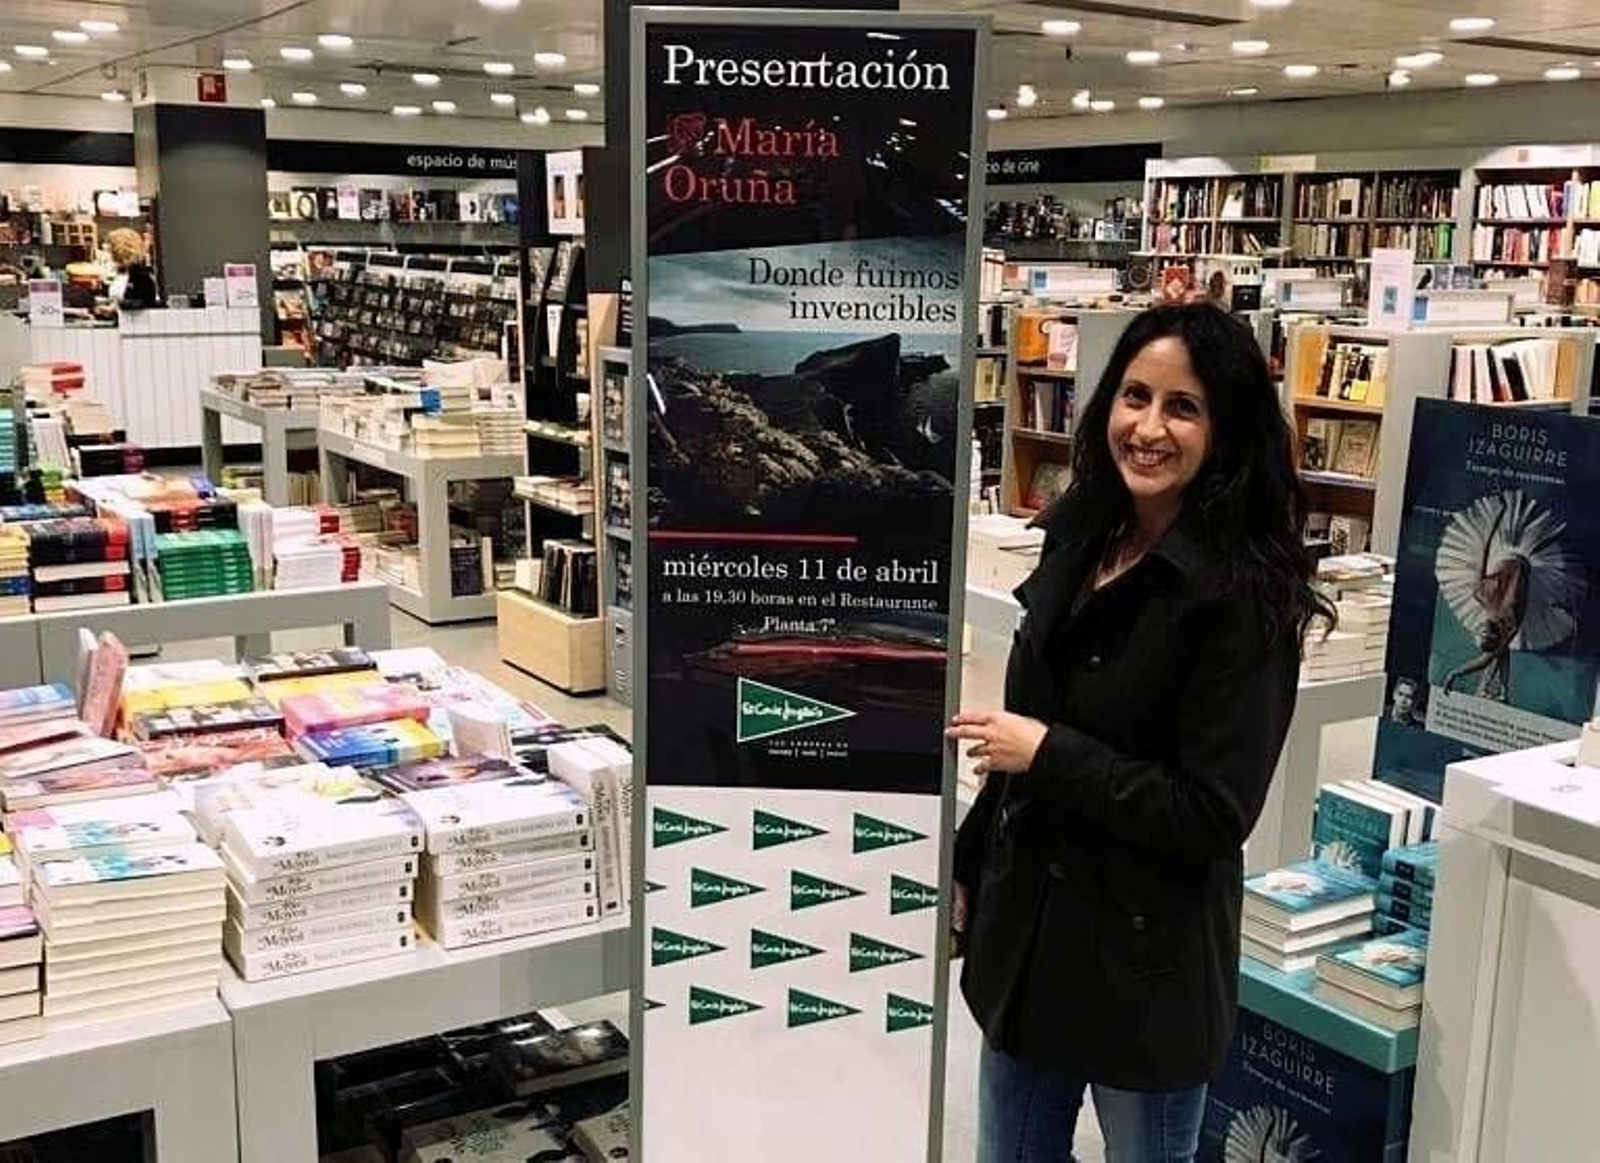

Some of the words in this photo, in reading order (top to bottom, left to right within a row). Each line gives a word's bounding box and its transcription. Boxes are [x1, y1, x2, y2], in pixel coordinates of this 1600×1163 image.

[661, 44, 950, 91] Presentación
[714, 117, 840, 157] María
[407, 152, 463, 172] espacio
[467, 153, 486, 169] de
[664, 166, 797, 204] Oruña
[747, 256, 845, 288] Donde
[855, 259, 961, 290] fuimos
[788, 290, 958, 322] invencibles
[1492, 423, 1548, 445] BORIS
[1467, 435, 1567, 468] IZAGUIRRE
[662, 553, 789, 578] miércoles
[799, 557, 827, 580] 11
[836, 557, 867, 581] de
[875, 558, 938, 584] abril
[662, 592, 673, 603] a
[676, 587, 700, 603] las
[750, 587, 794, 605] horas
[797, 594, 817, 607] en
[821, 592, 836, 607] el
[840, 592, 938, 609] Restaurante
[1242, 1032, 1334, 1095] IZAGUIRRE
